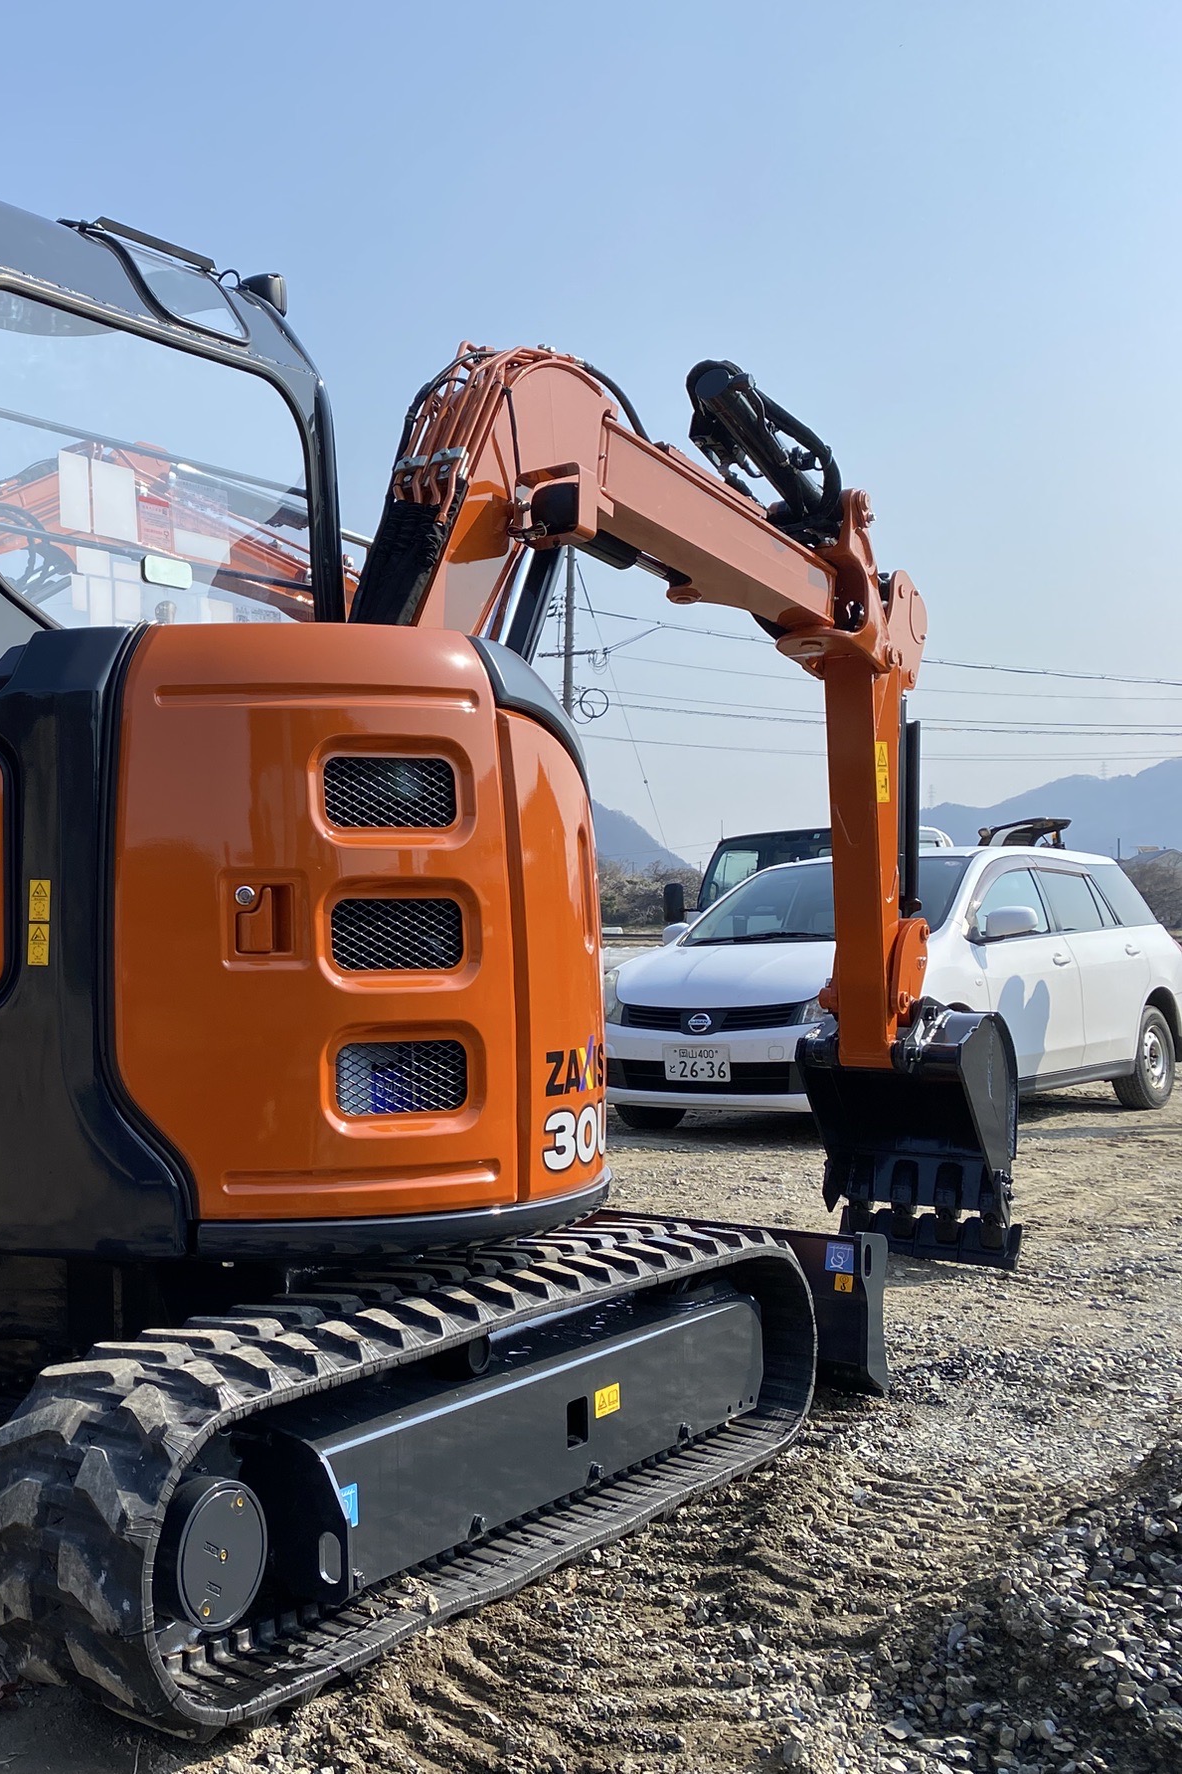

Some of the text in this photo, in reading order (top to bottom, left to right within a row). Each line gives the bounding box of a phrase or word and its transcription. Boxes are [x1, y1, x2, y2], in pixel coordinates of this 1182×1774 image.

[545, 1034, 604, 1098] ZAXIS
[669, 1060, 726, 1079] と 26-36
